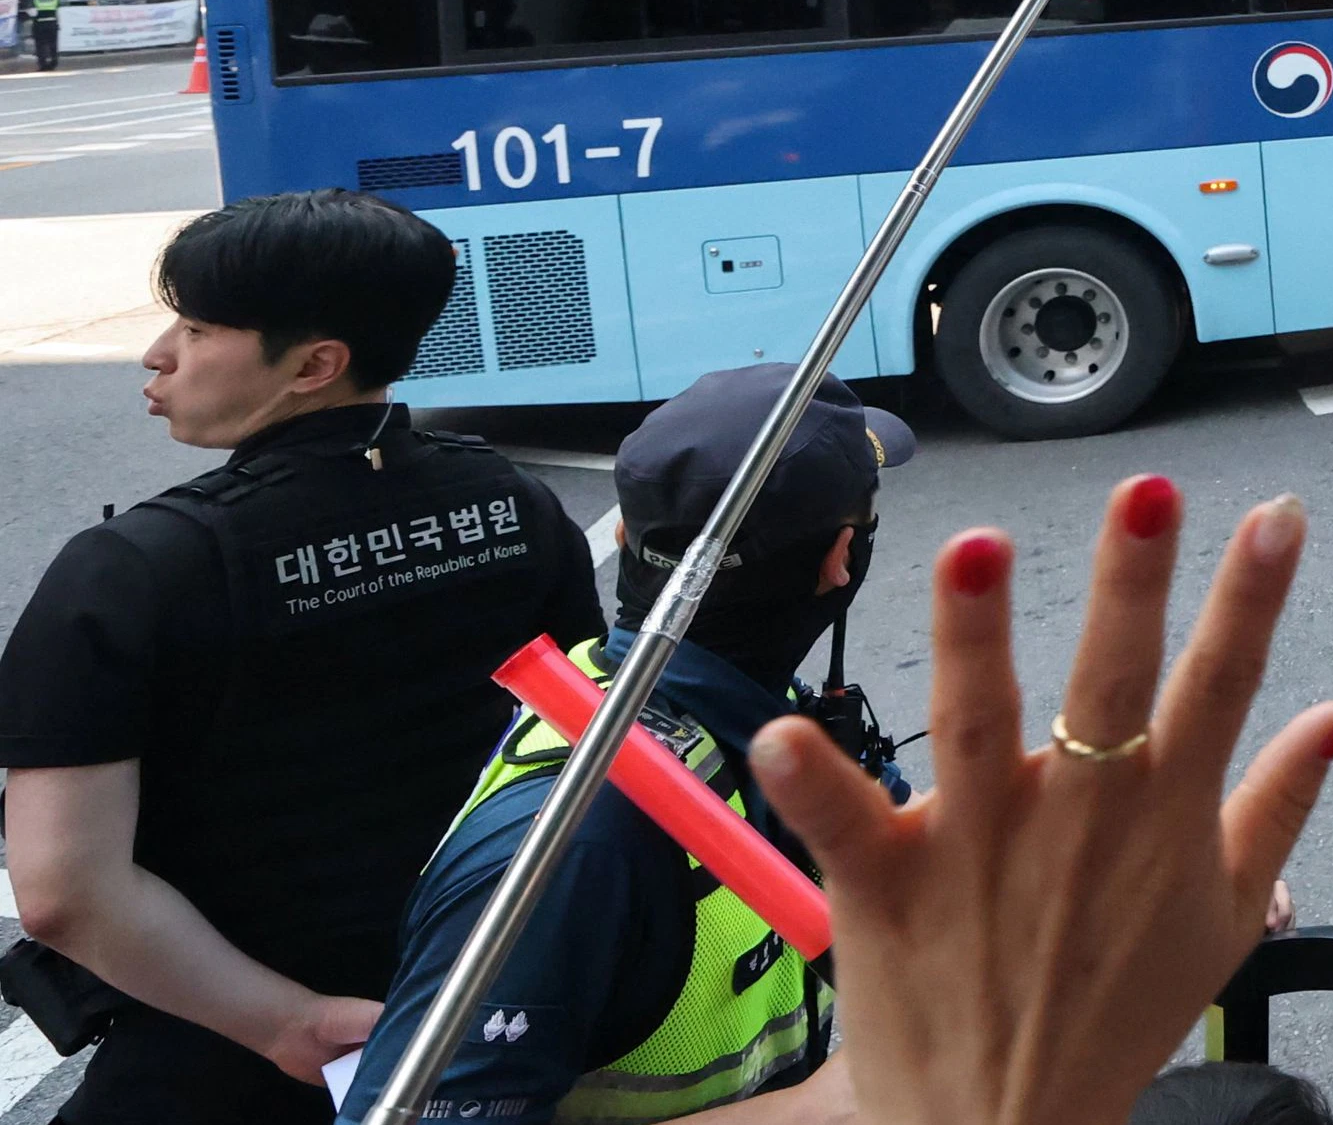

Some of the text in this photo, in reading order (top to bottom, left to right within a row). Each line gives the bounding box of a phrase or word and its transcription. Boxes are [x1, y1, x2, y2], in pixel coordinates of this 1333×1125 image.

[451, 117, 663, 191] 101-7
[286, 541, 529, 615] The Court of the Republic of Korea
